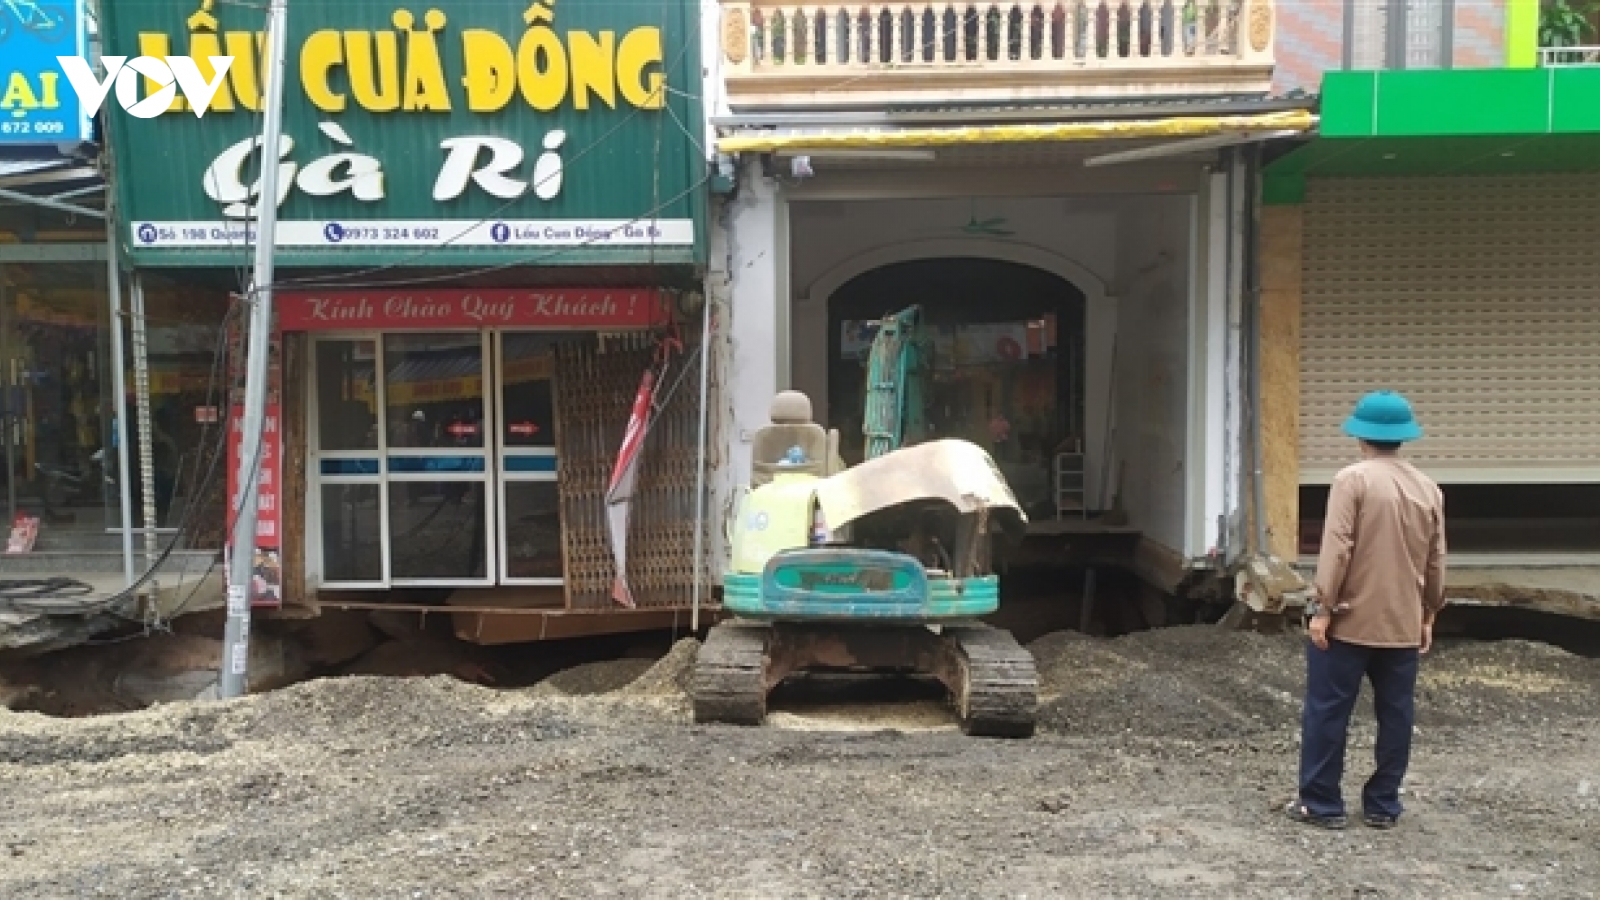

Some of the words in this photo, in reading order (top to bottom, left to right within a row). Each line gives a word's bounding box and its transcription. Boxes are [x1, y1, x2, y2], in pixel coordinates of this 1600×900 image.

[203, 121, 385, 217] Gà
[432, 129, 567, 201] Ri
[383, 228, 409, 240] 324
[304, 297, 374, 320] Kính
[383, 296, 452, 318] Chào
[461, 294, 515, 320] Quý
[527, 294, 616, 317] Khách
